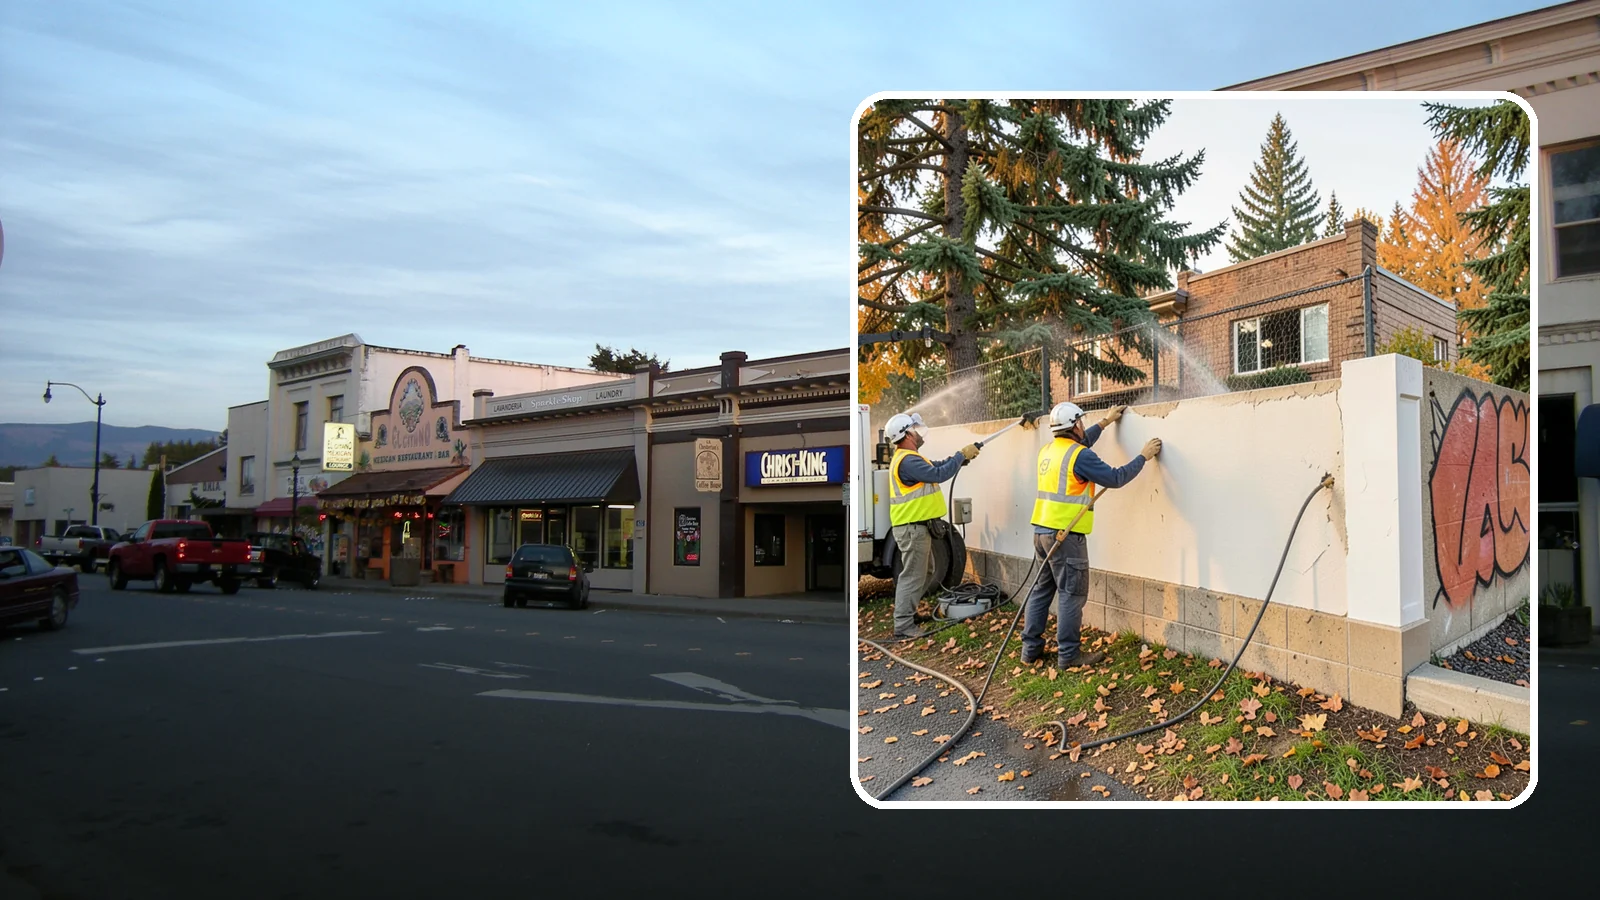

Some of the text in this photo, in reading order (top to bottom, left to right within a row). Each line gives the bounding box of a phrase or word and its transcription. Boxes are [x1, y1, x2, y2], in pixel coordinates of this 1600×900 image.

[493, 389, 623, 412] LAVANDERIA Sparkle Shop LAUNDRY
[373, 450, 450, 464] MEXICAN RESTAURANT BAR
[761, 450, 827, 477] CHRIST KING
